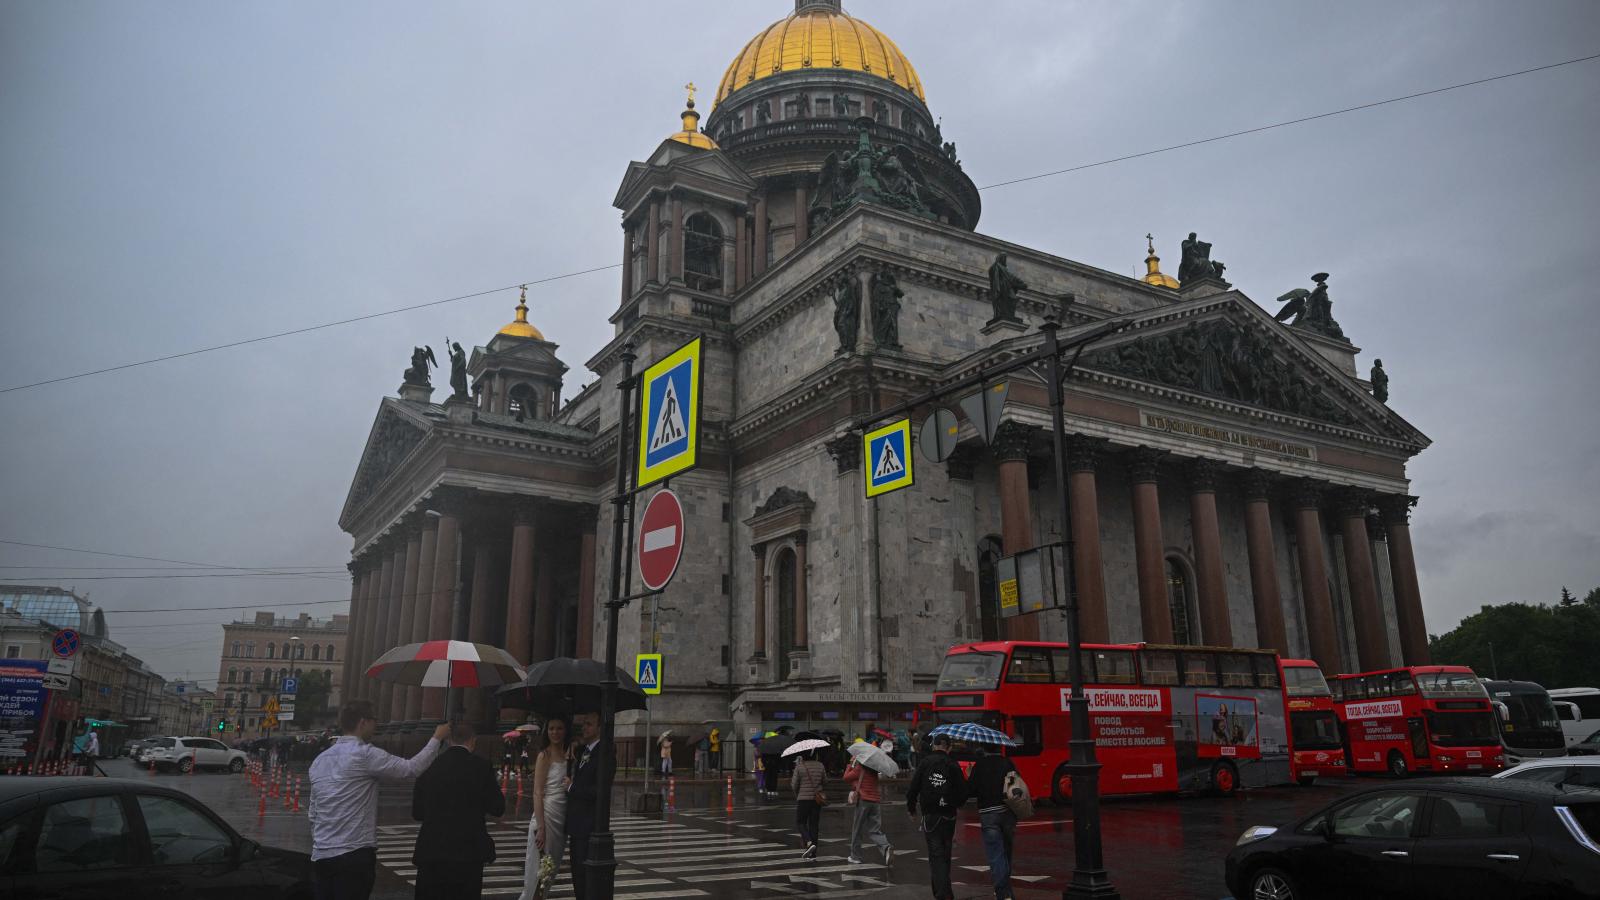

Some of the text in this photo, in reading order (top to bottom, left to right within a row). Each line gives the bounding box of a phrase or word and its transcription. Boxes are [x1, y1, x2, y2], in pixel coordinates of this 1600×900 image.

[285, 679, 295, 691] P
[1094, 691, 1128, 708] СЕЙЧАС,
[1129, 694, 1158, 708] ВСЕГДА
[1094, 716, 1121, 726] ПОВОД
[1100, 727, 1145, 736] СОБРАТЬСЯ
[1095, 737, 1166, 746] ВМЕСТЕ В МОСКВЕ
